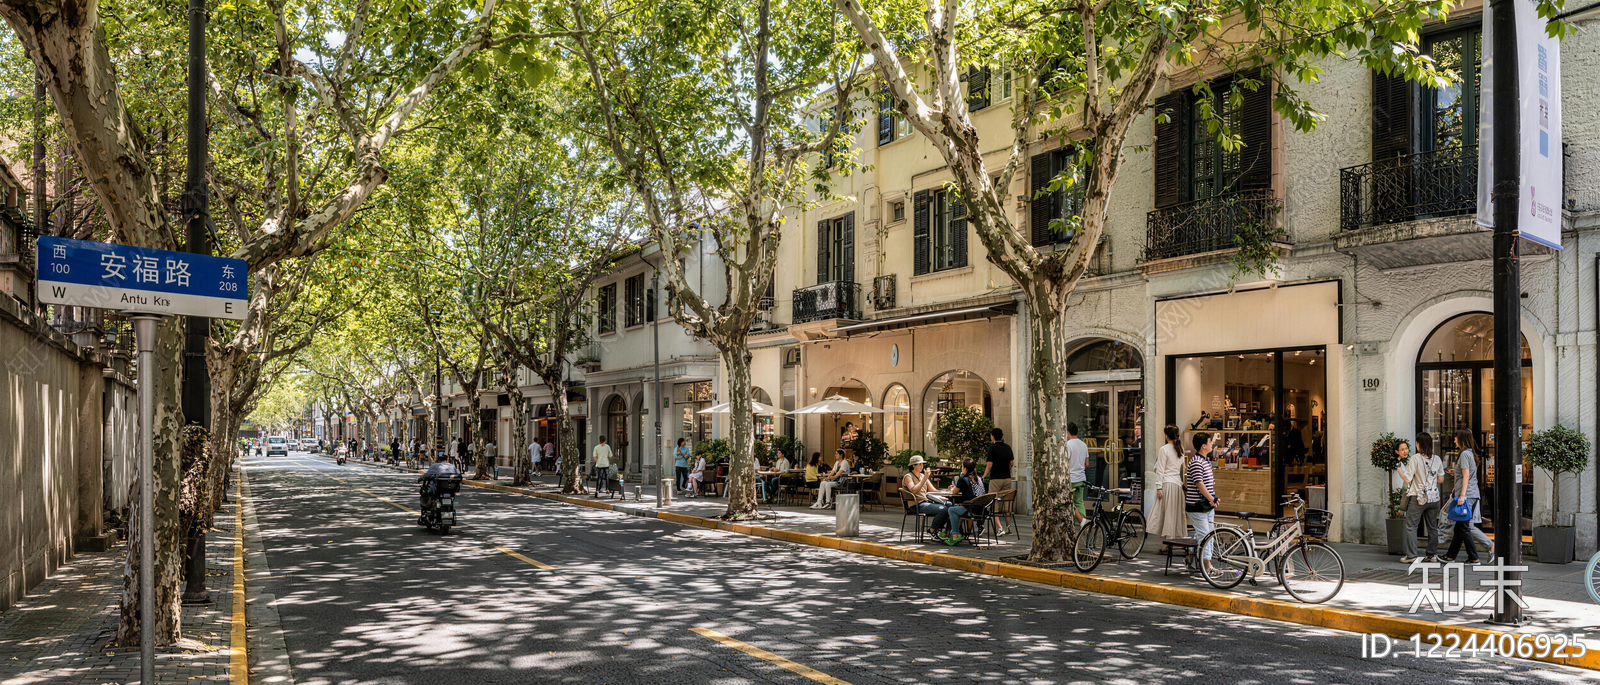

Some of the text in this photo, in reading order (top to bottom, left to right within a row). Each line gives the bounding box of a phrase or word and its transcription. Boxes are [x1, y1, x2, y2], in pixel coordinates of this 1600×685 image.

[53, 244, 67, 260] 西
[51, 263, 70, 274] 100
[100, 251, 192, 287] 安福路
[222, 265, 235, 279] 东
[52, 286, 67, 299] W
[219, 281, 238, 292] 208
[120, 292, 147, 305] Antu
[224, 302, 233, 314] E
[1362, 378, 1380, 388] 180
